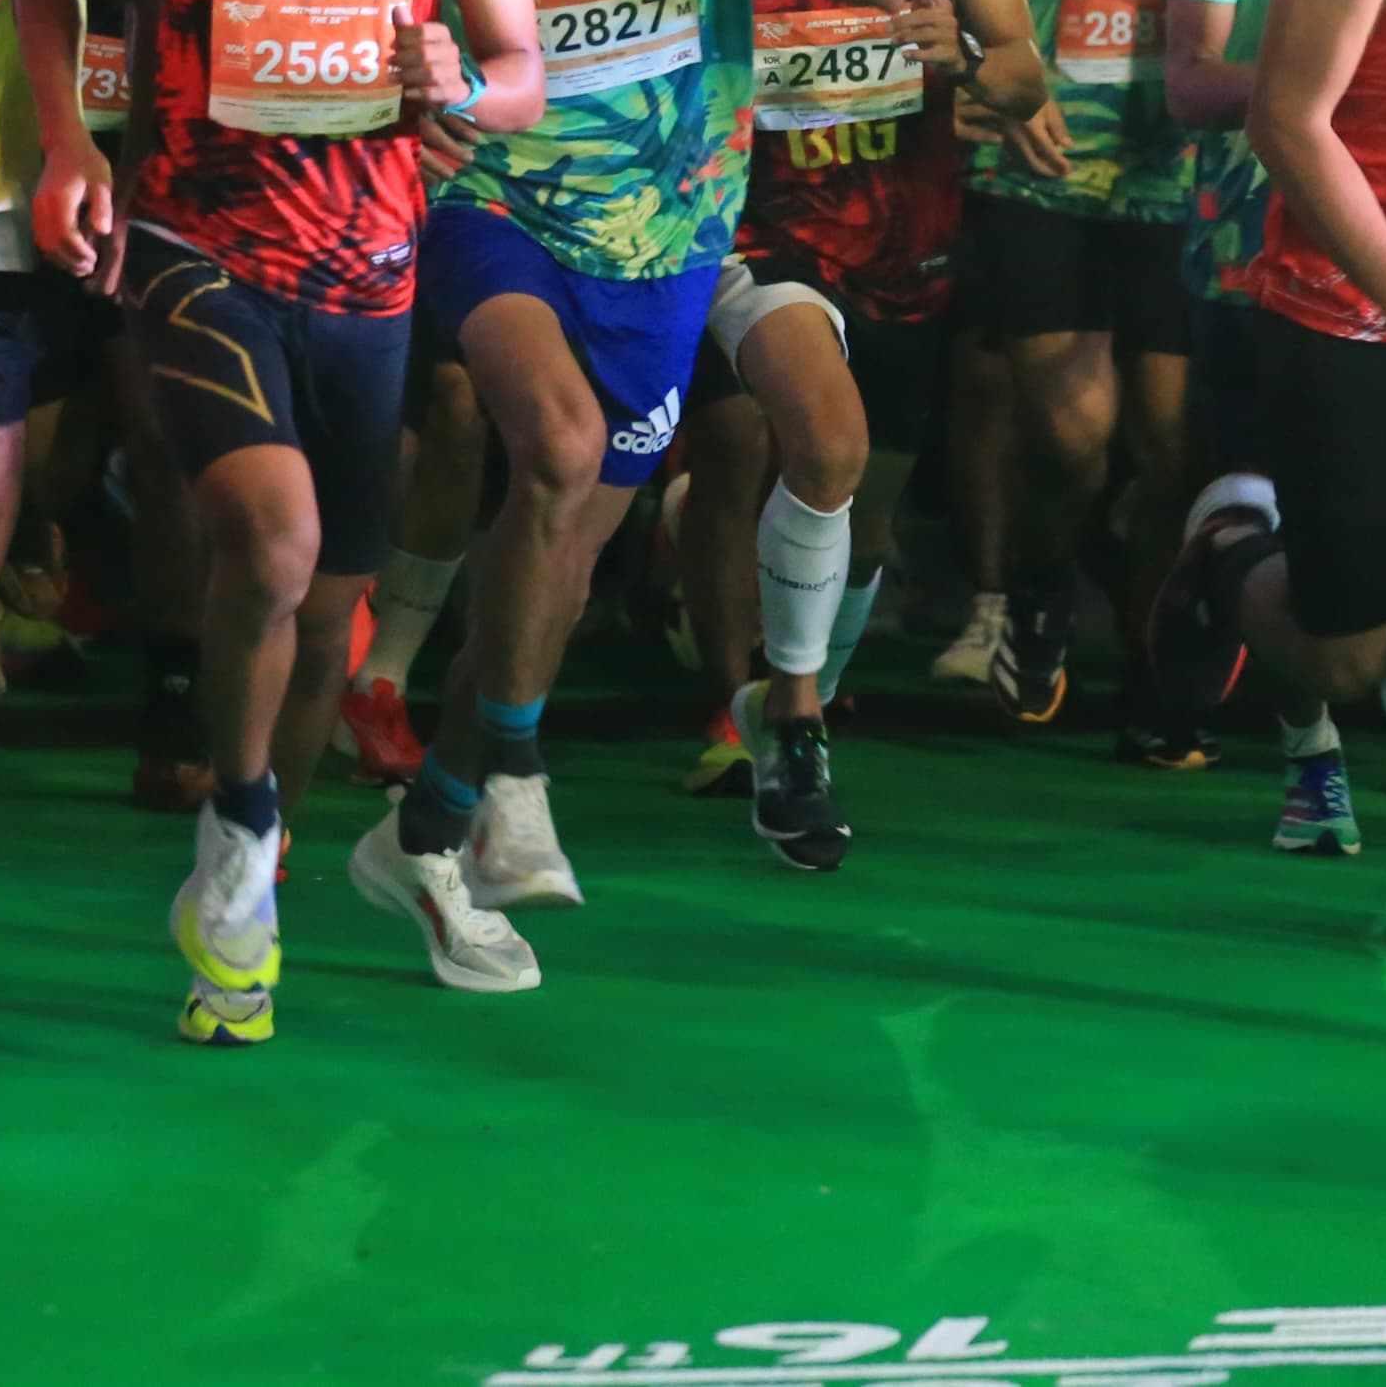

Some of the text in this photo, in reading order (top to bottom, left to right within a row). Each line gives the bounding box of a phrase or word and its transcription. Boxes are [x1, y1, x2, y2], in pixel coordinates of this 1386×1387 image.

[676, 1, 691, 17] M
[253, 39, 380, 85] 2563
[763, 55, 781, 65] 10K
[765, 71, 781, 86] A
[789, 44, 897, 87] 2487
